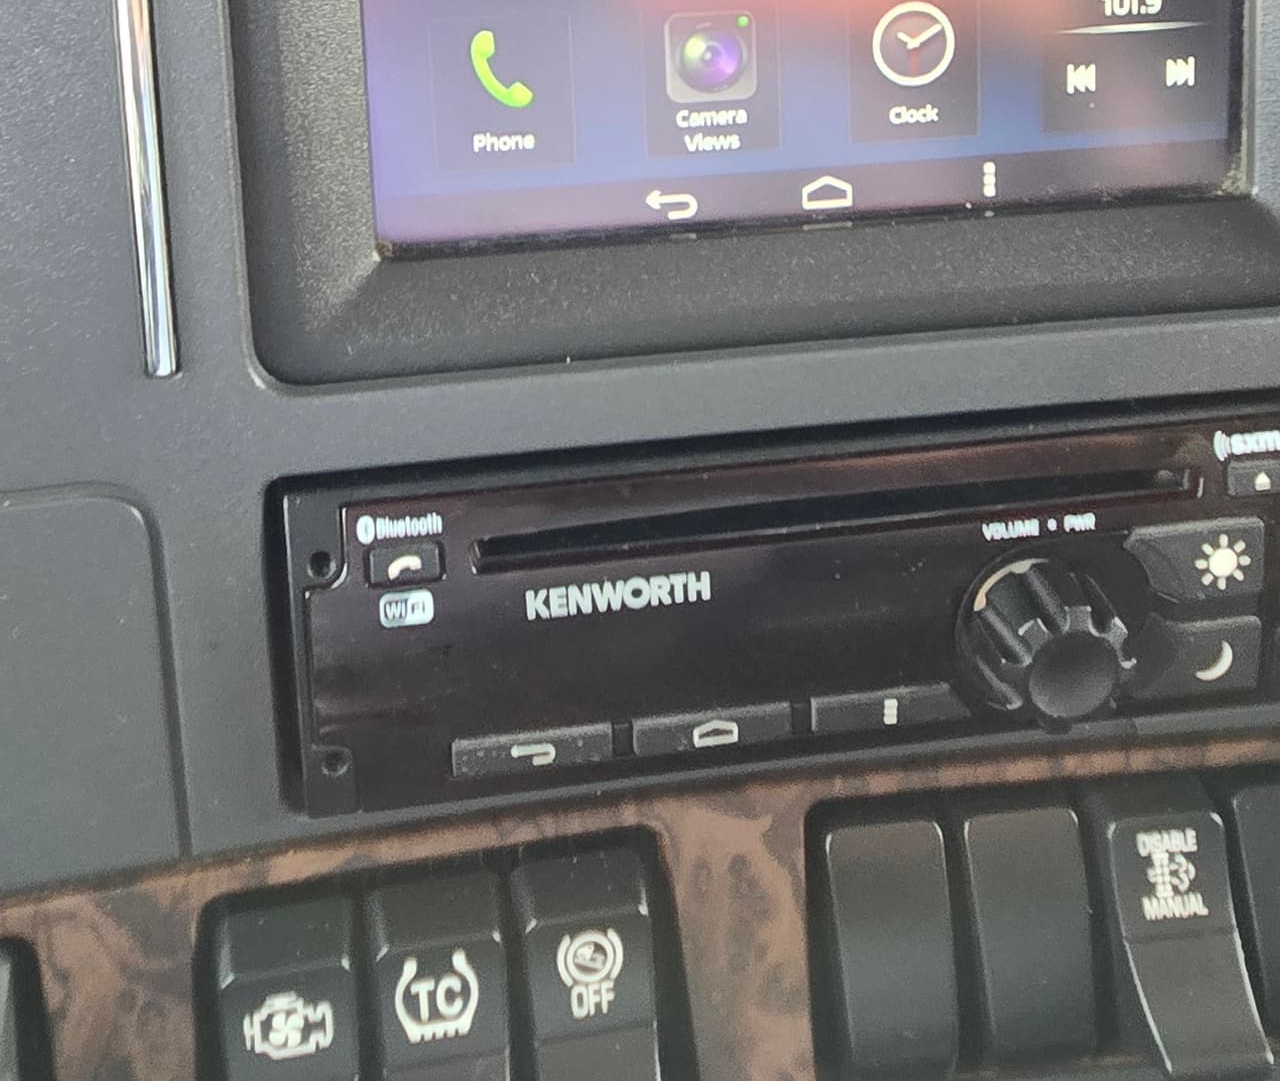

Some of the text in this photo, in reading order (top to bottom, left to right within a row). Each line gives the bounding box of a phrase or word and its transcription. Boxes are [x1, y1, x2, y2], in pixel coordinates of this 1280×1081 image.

[675, 109, 749, 129] Camera
[889, 104, 940, 125] Clock
[472, 132, 536, 153] Phone
[683, 132, 741, 153] Views
[375, 512, 444, 541] Bluetooth
[981, 512, 1097, 542] VOLUME PWR
[524, 571, 713, 622] KENWORTH
[1142, 891, 1210, 920] MANUAL
[410, 972, 464, 1023] TC
[571, 980, 616, 1019] OFF
